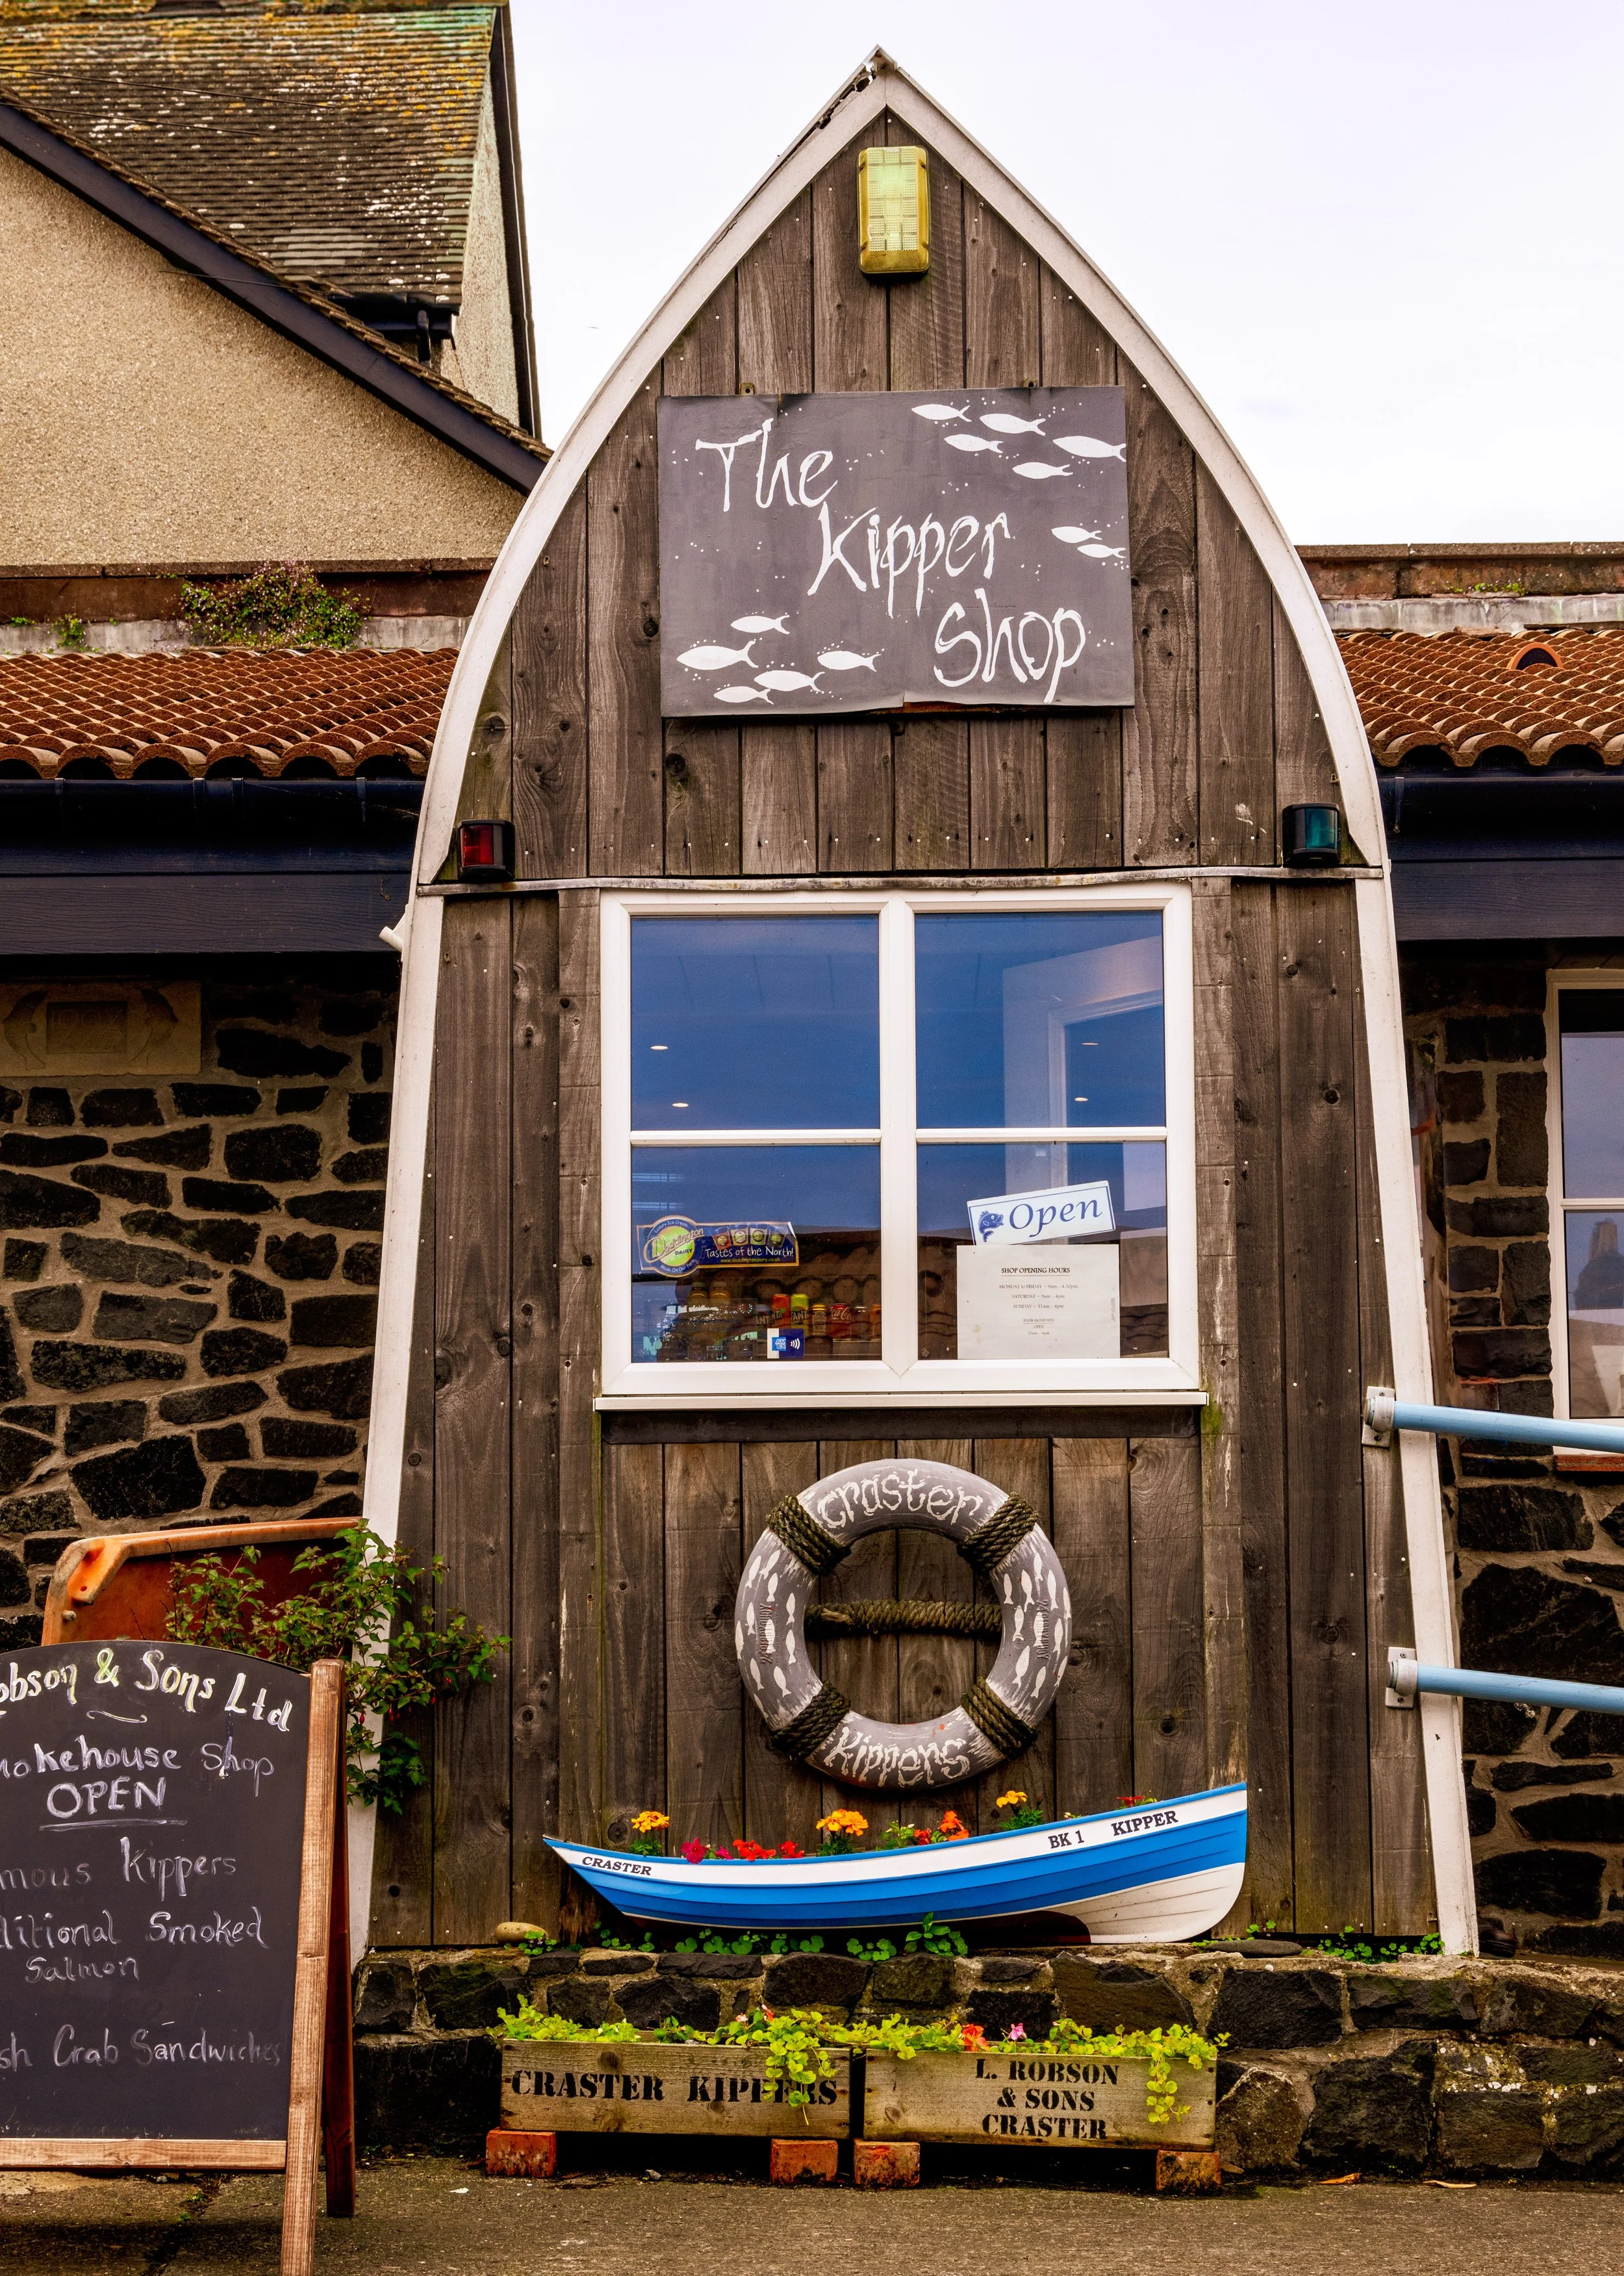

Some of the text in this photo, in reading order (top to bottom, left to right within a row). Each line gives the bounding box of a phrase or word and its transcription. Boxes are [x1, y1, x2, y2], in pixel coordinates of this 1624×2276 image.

[694, 417, 839, 513] The
[806, 501, 1011, 620] Kipper
[933, 587, 1086, 705] Shop
[654, 1222, 667, 1233] Luxury
[1009, 1198, 1103, 1238] Open
[651, 1228, 704, 1259] Doddington
[705, 1246, 794, 1258] Tastes of the North!
[659, 1263, 672, 1272] Made
[94, 1647, 120, 1688] &
[134, 1649, 216, 1713] Sons
[224, 1672, 293, 1732] Ltd
[200, 1736, 275, 1798] Shop
[822, 1726, 971, 1788] Kippers
[46, 1775, 166, 1819] OPEN
[581, 1810, 1178, 1876] CRASTER BK 1 KIPPER
[146, 1906, 270, 1949] Smoked
[25, 1956, 140, 1984] Salmon
[53, 2024, 119, 2067] Crab
[130, 2027, 282, 2067] Sandwiches
[511, 2069, 665, 2101] CRASTER
[974, 2058, 1119, 2086] L. ROBSON
[996, 2086, 1095, 2112] & SONS
[982, 2113, 1108, 2140] CRASTER
